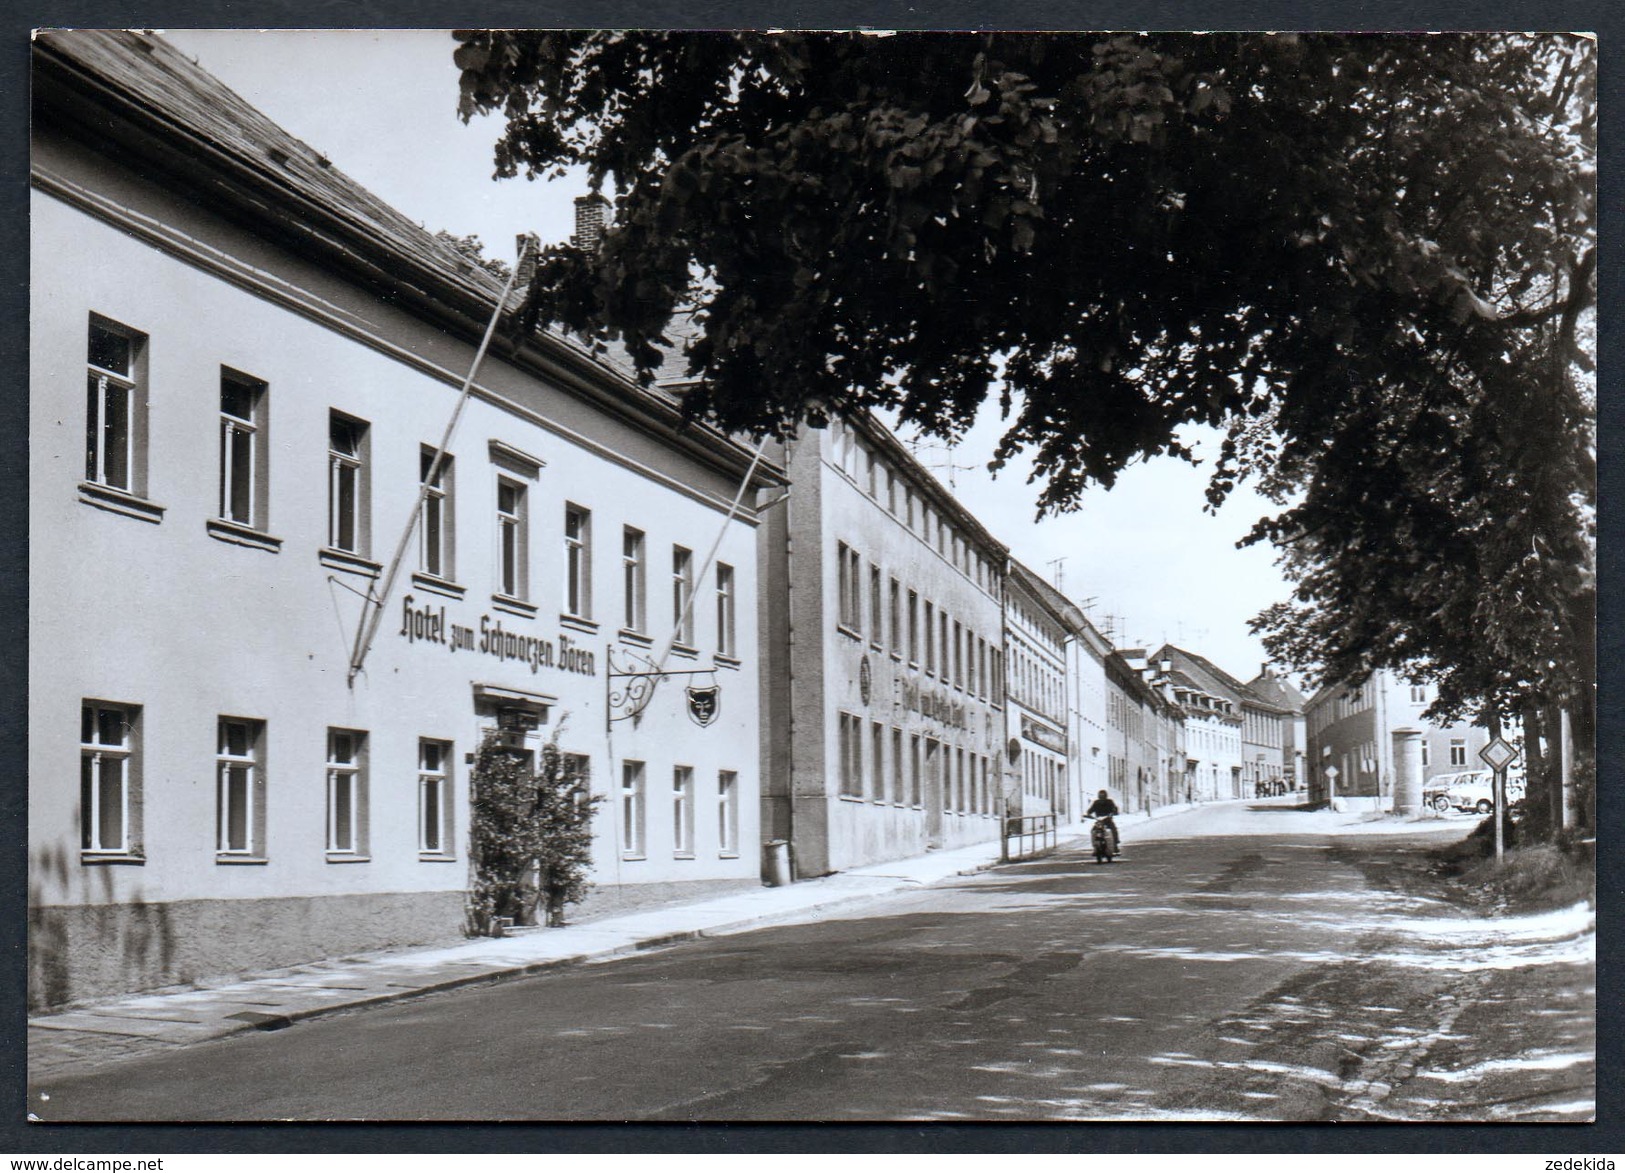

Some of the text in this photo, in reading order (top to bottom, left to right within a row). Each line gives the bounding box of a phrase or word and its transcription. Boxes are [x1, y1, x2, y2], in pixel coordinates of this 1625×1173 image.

[400, 594, 446, 644] Hotel
[450, 623, 475, 652] zum
[480, 614, 554, 674] Schwarzen
